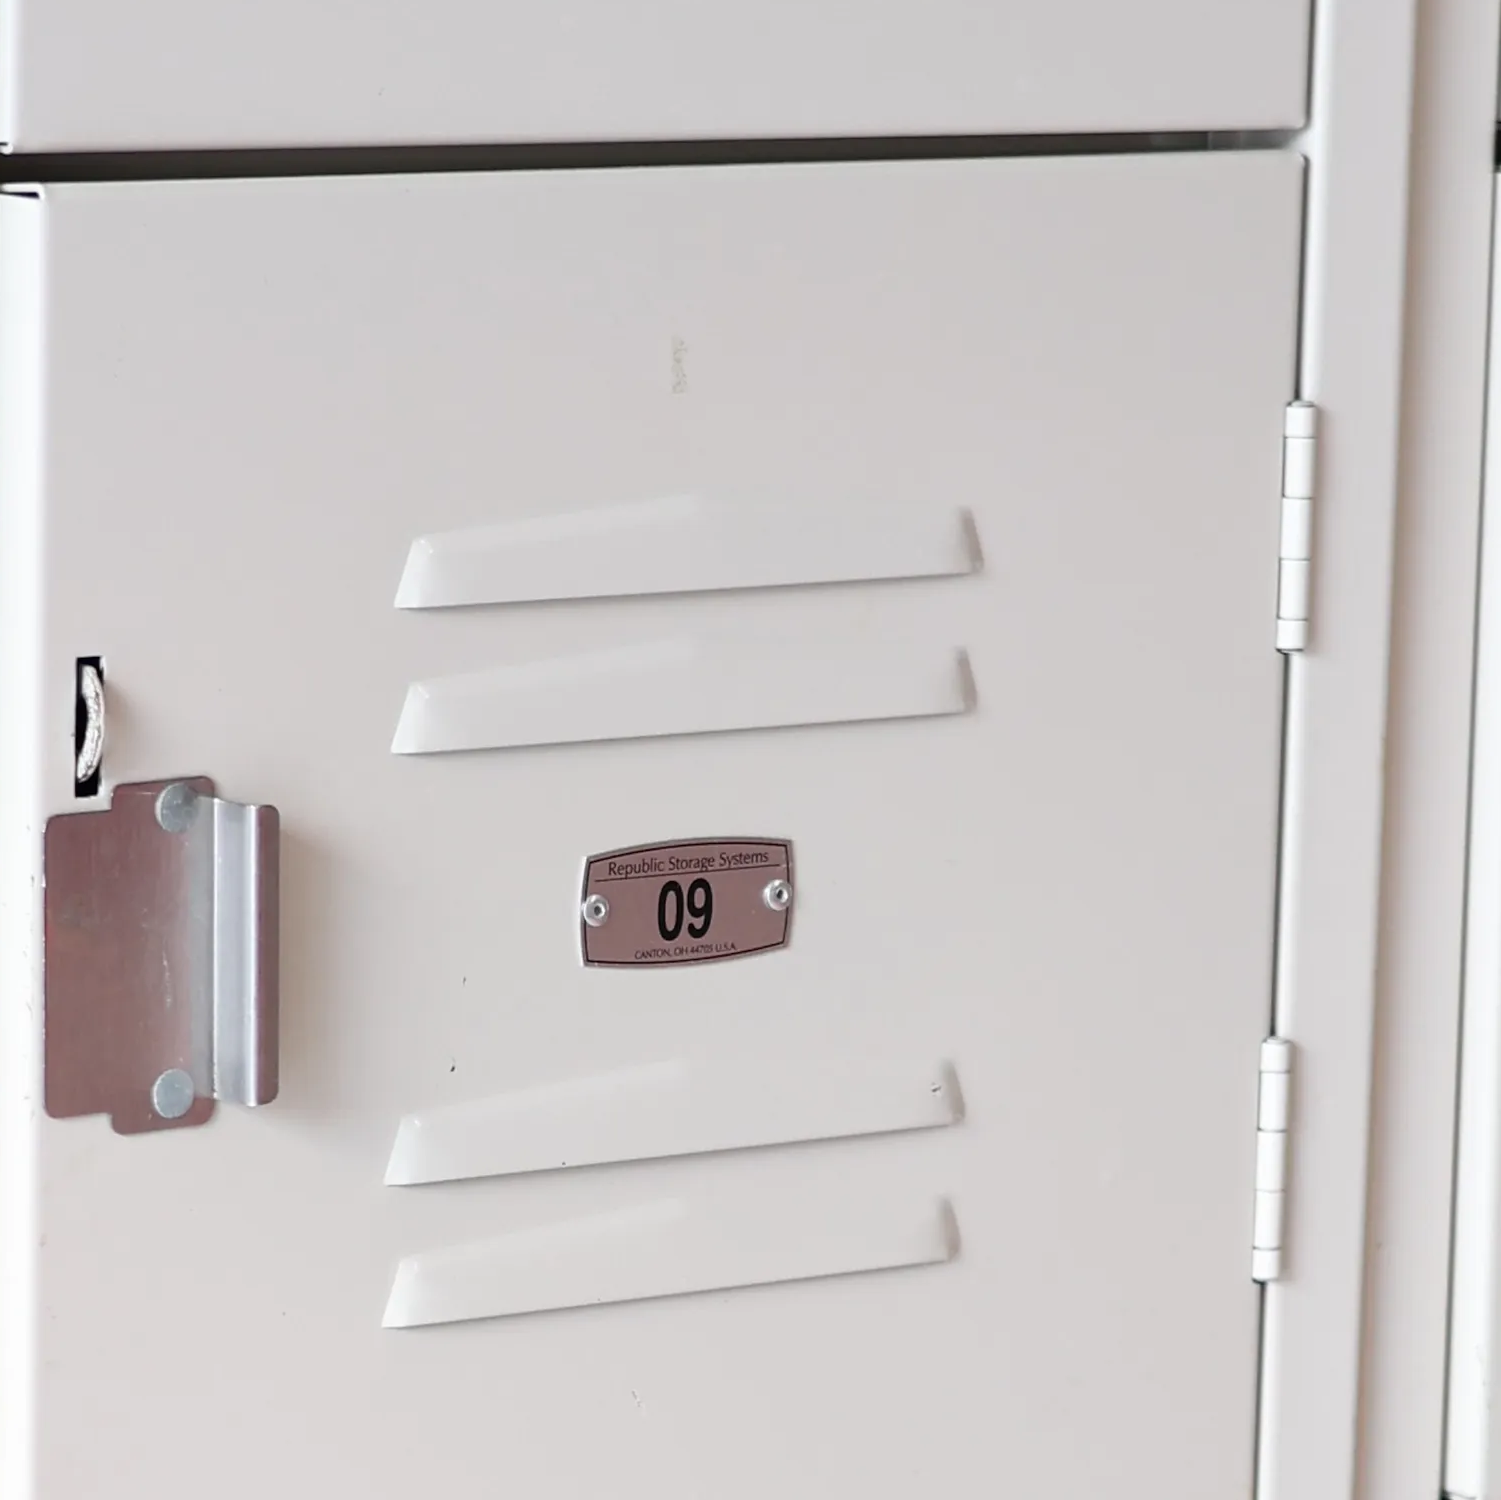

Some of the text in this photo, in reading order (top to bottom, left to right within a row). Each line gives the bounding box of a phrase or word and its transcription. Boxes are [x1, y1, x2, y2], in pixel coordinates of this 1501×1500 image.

[608, 851, 769, 879] Republic Storage Systems
[658, 878, 713, 941] 09
[674, 946, 688, 956] OH
